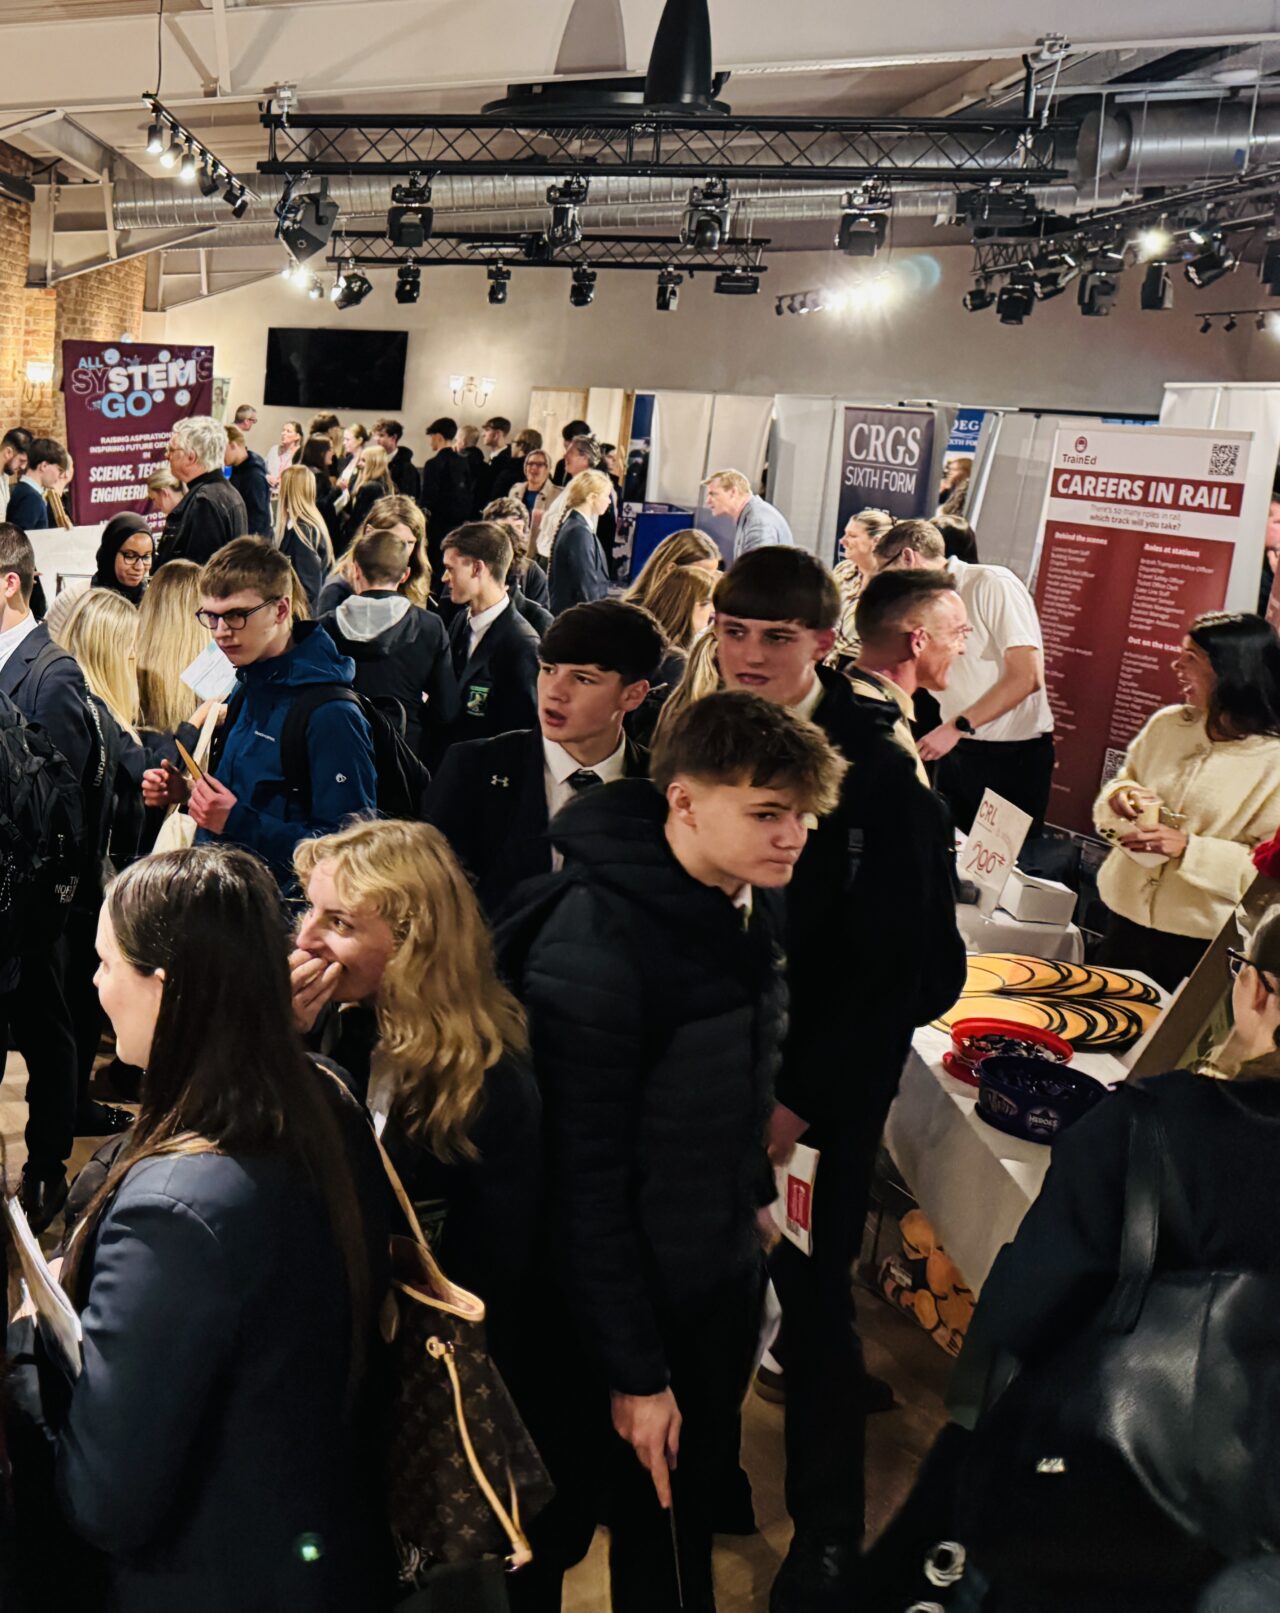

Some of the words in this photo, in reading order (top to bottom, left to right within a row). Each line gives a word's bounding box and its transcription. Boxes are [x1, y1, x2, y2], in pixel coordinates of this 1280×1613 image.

[78, 356, 103, 369] ALL
[101, 390, 153, 419] GO
[100, 436, 130, 444] RAISING
[130, 432, 172, 443] ASPIRATION
[849, 423, 920, 466] CRGS
[90, 445, 125, 454] INSPIRING
[126, 442, 154, 451] FUTURE
[1062, 454, 1097, 465] TrainEd
[89, 465, 135, 482] SCIENCE,
[845, 466, 880, 490] SIXTH
[881, 472, 916, 495] FORM
[1057, 474, 1144, 500] CAREERS
[1148, 482, 1175, 504] IN
[1178, 484, 1232, 510] RAIL
[1090, 514, 1110, 522] which
[1112, 516, 1130, 524] track
[1131, 518, 1144, 526] will
[1161, 522, 1181, 530] take?
[1054, 532, 1075, 540] Behind
[1076, 534, 1086, 542] the
